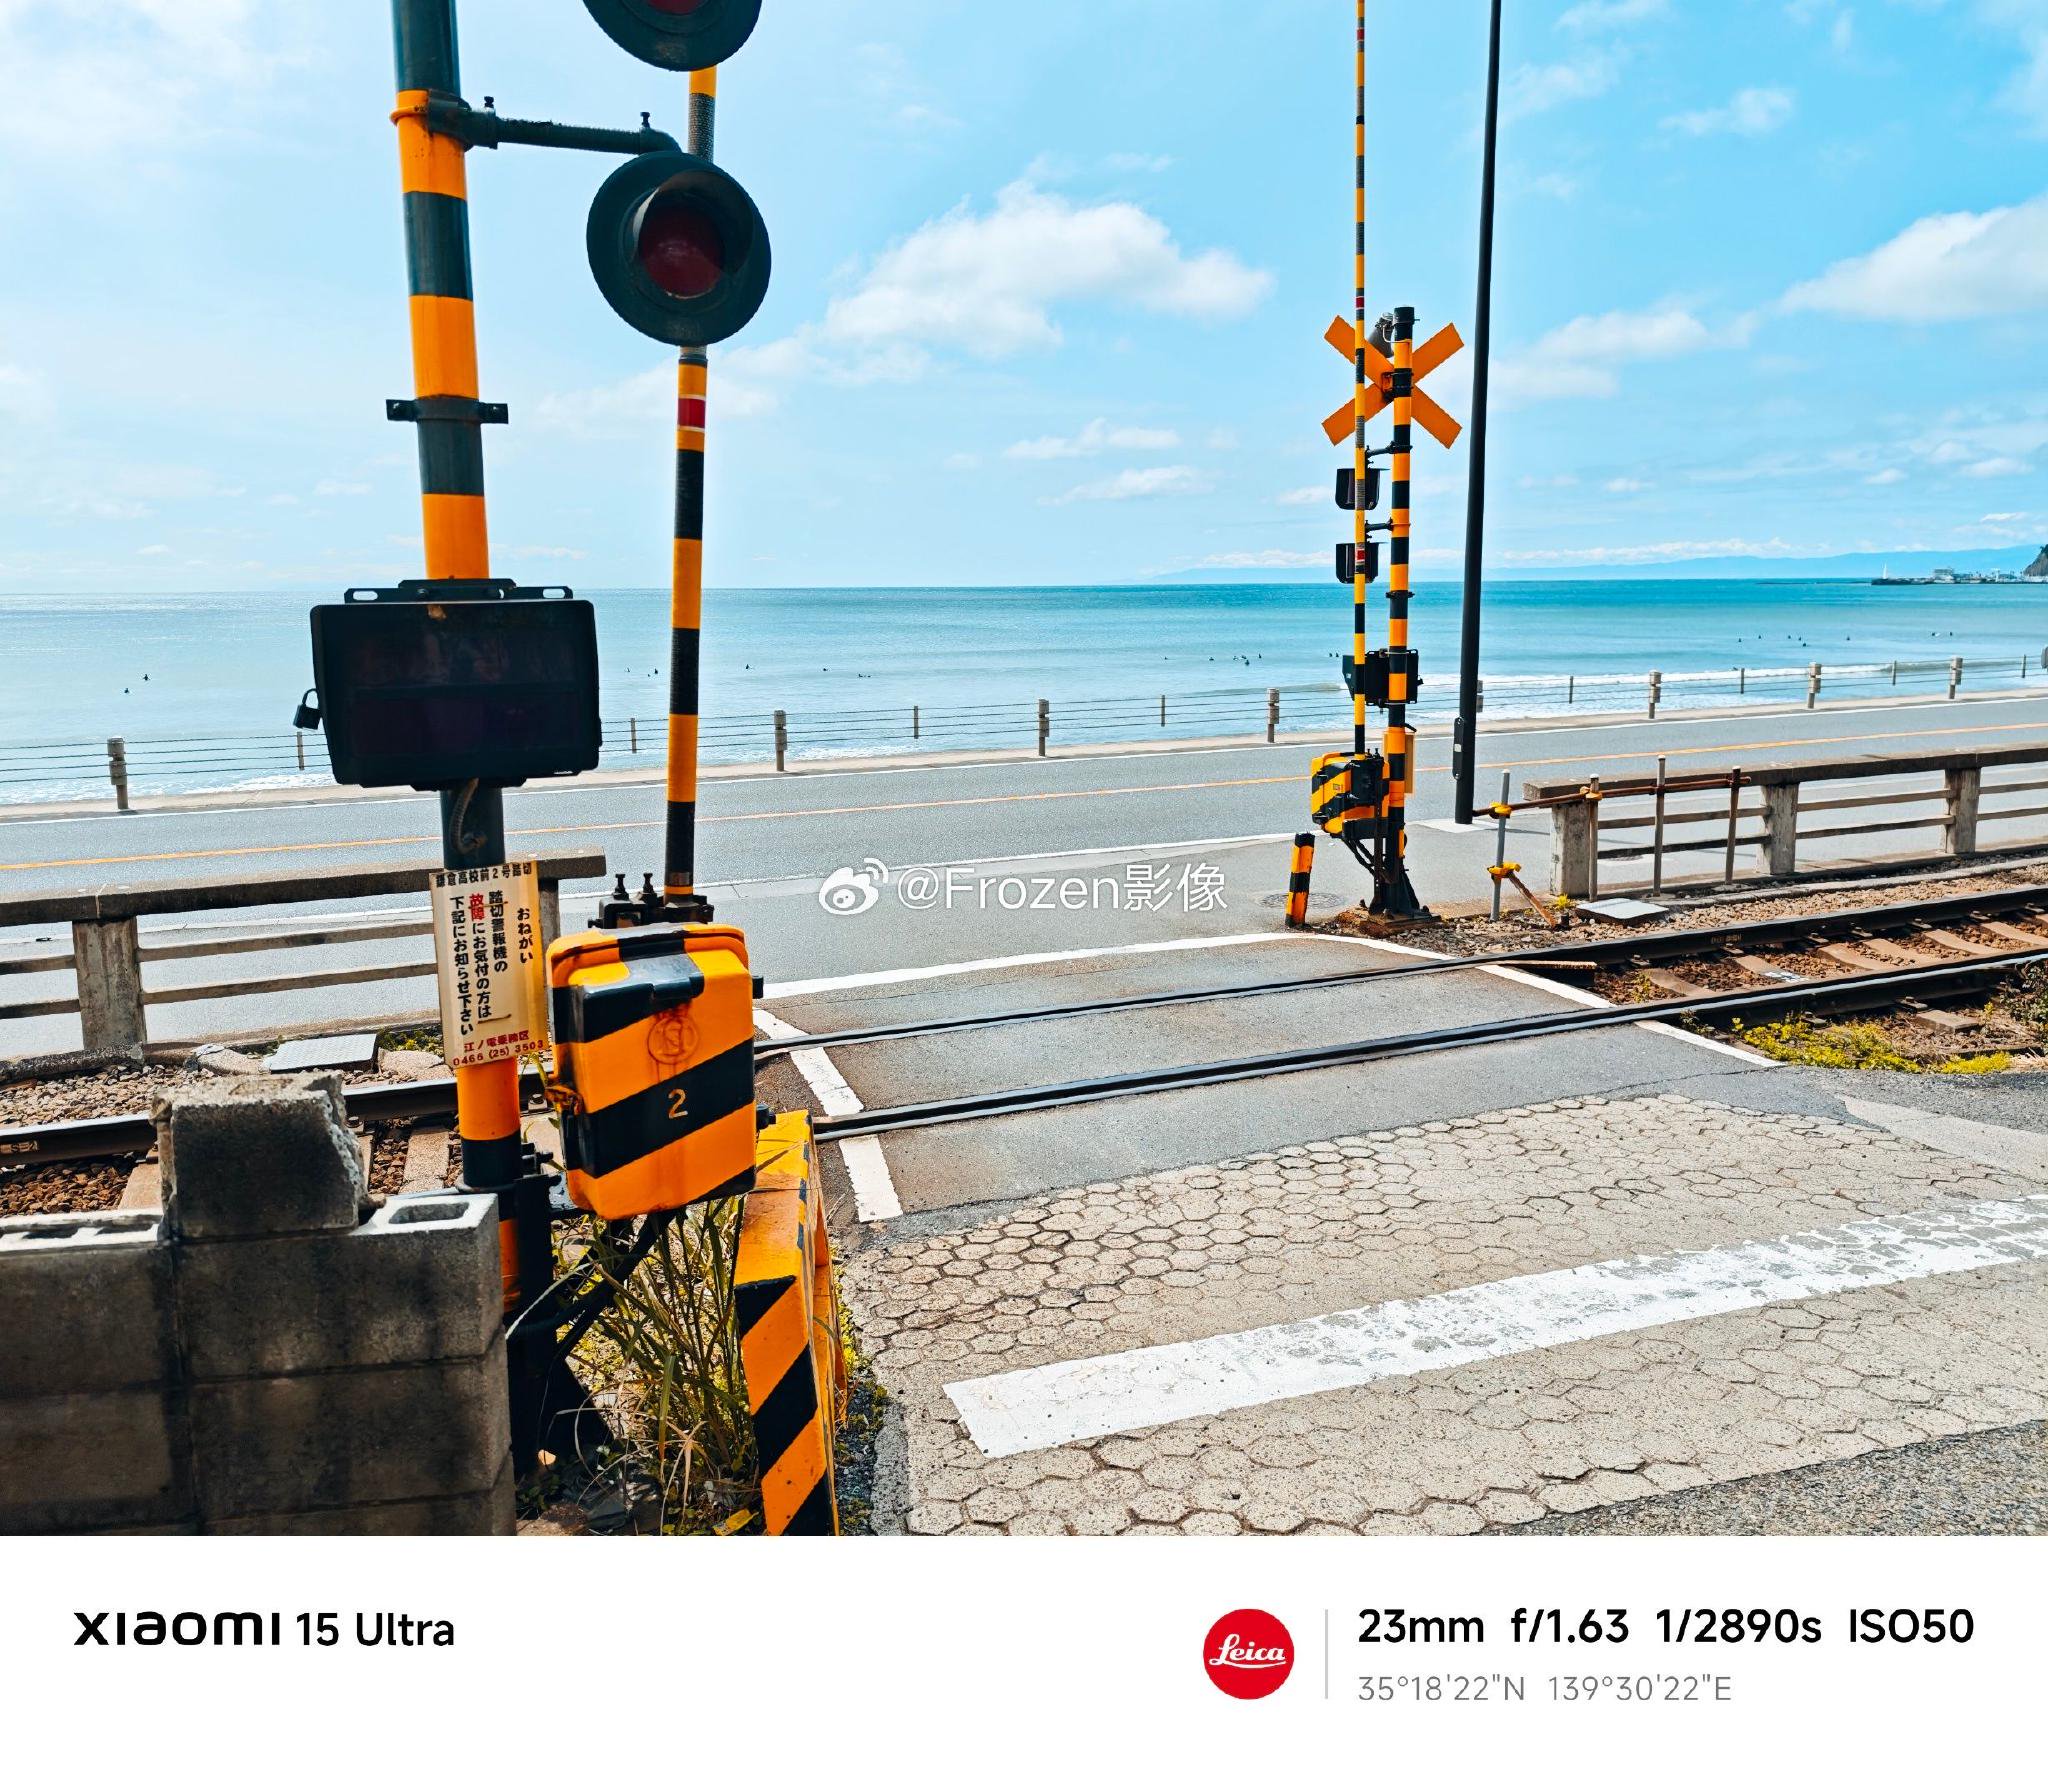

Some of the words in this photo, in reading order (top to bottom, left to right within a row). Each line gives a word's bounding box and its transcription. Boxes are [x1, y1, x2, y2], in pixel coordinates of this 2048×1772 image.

[450, 896, 474, 1036] 下記にお知らせ下さい
[469, 893, 492, 1019] 故障にお気付の方は
[489, 890, 508, 973] 踏切警報機の
[517, 907, 534, 964] おねがい
[453, 1053, 483, 1066] 0466
[489, 1046, 510, 1059] (25)
[515, 1040, 544, 1053] 3503
[668, 1089, 688, 1119] 2
